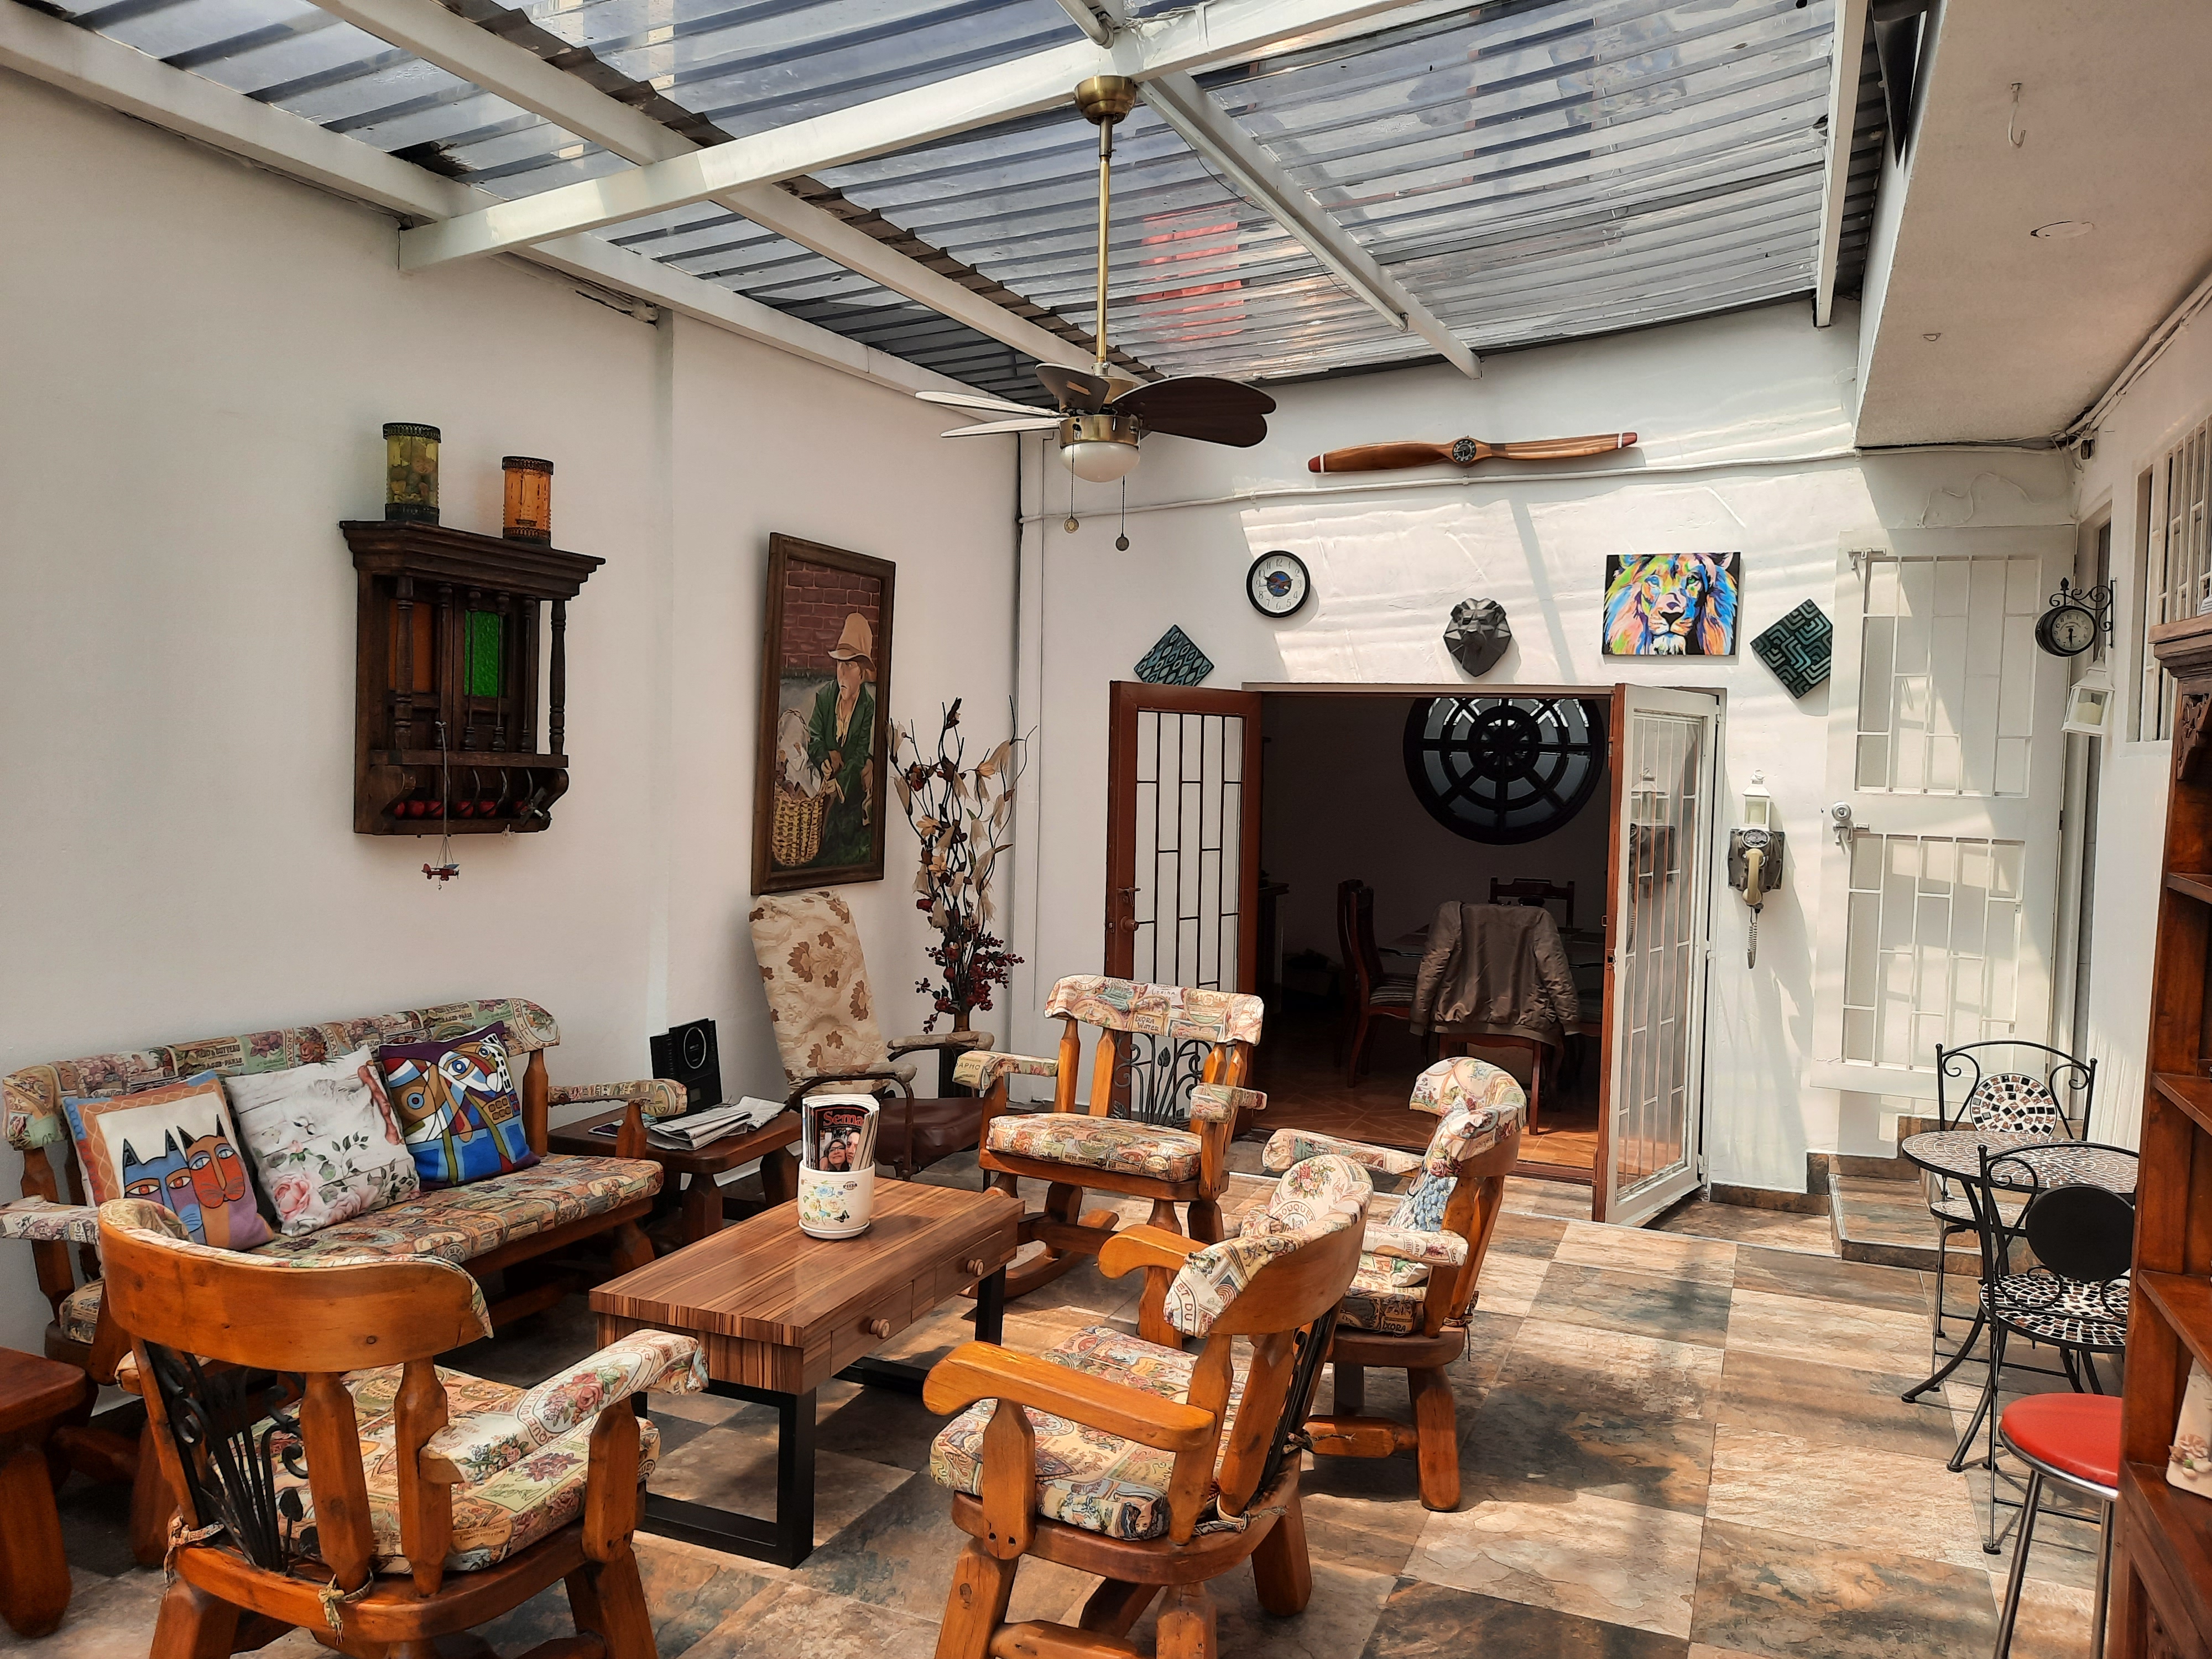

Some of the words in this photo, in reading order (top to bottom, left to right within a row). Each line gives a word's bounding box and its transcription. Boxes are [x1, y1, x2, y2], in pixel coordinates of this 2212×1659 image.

[1266, 561, 1271, 570] 11
[1276, 559, 1282, 567] 12
[1288, 561, 1293, 569] 1
[1258, 569, 1265, 578] 10
[1295, 568, 1300, 577] 2
[1297, 580, 1302, 589] 3
[1258, 590, 1264, 599] 8
[1293, 591, 1298, 599] 4
[1266, 598, 1270, 607] 7
[1276, 602, 1281, 611] 6
[1286, 598, 1291, 607] 5
[823, 1110, 864, 1127] Sema
[1275, 1203, 1314, 1222] BOUQUET
[1184, 1302, 1193, 1322] DU
[520, 1404, 531, 1416] DU
[528, 1378, 560, 1402] LIBAN
